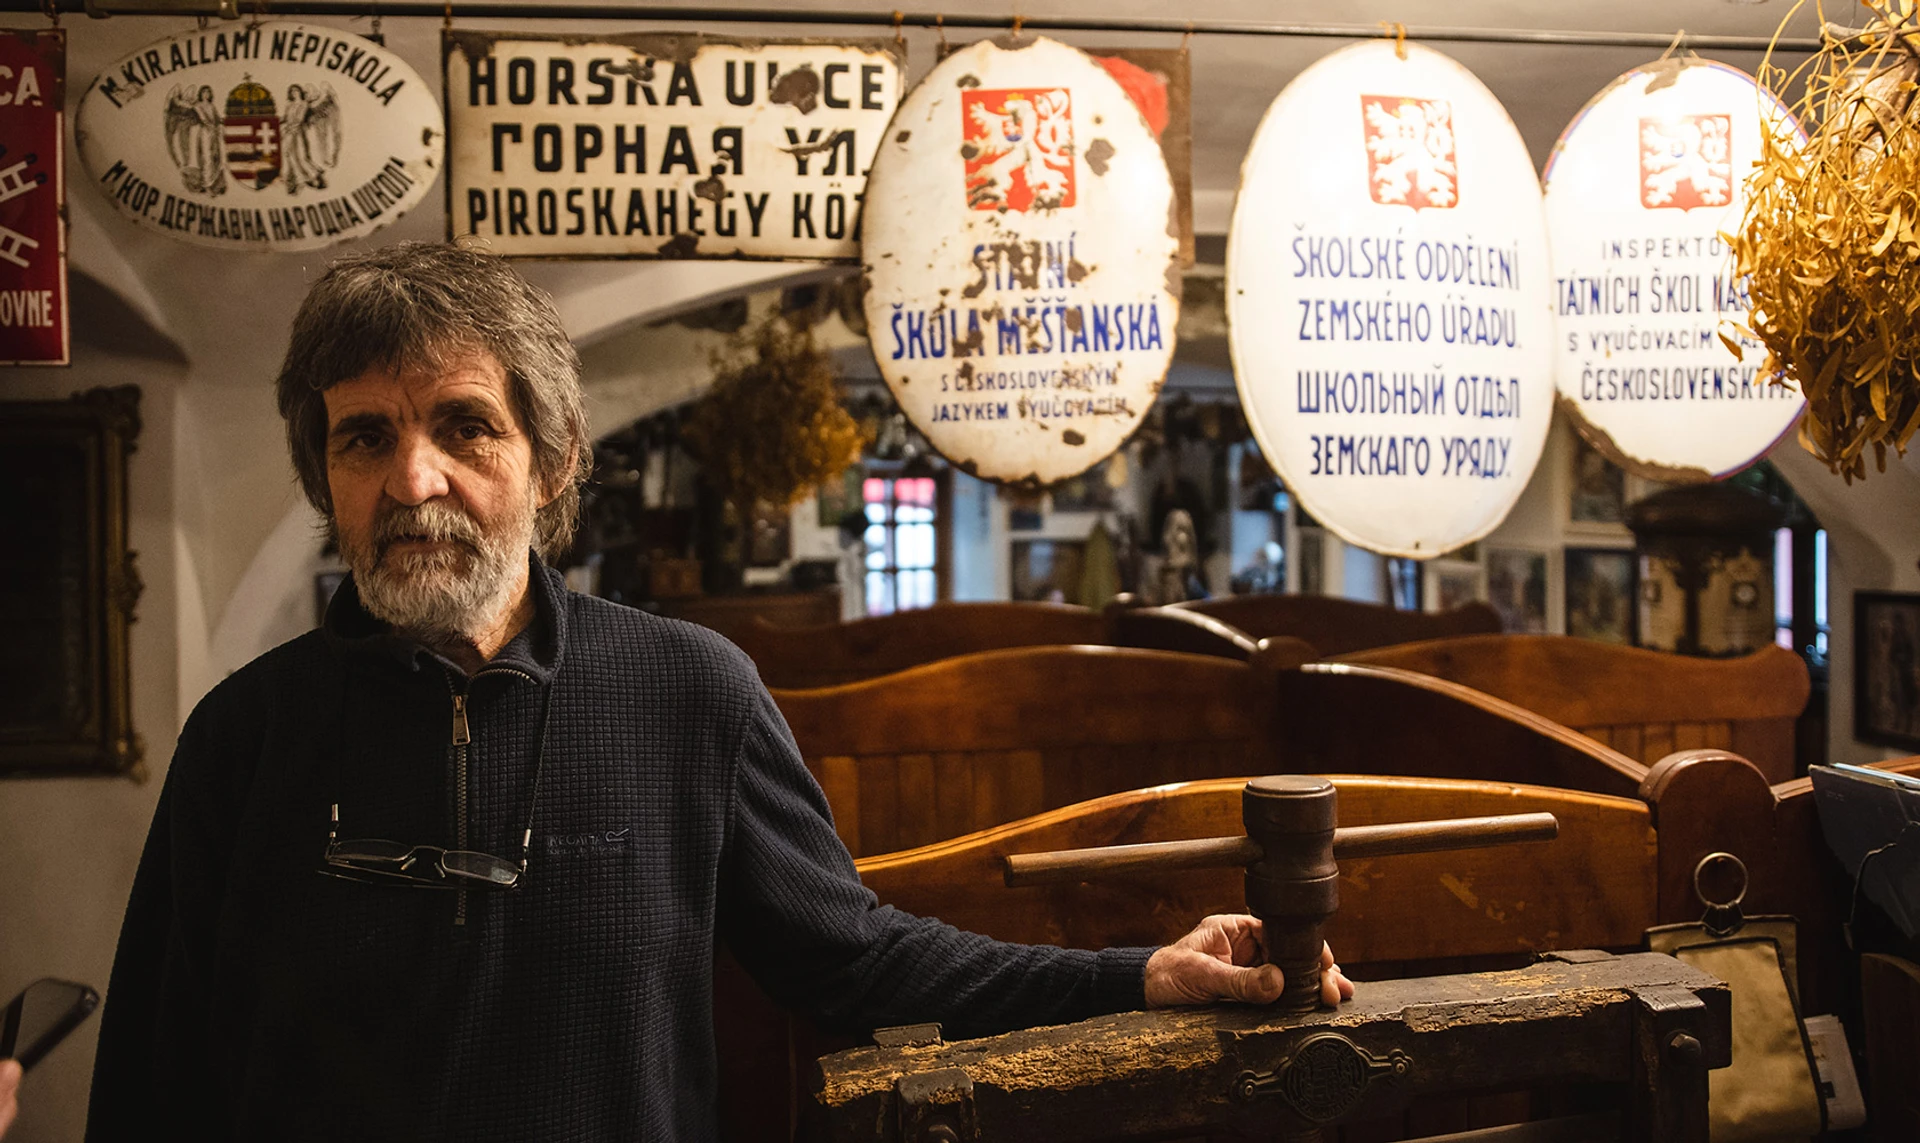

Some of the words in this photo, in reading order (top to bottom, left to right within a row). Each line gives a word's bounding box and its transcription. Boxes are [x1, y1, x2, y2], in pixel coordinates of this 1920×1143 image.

[269, 26, 406, 106] NÉPISKOLA
[726, 60, 884, 110] UCE
[492, 123, 744, 175] ГОРНАЯ
[268, 196, 363, 241] НАРОДНА
[468, 187, 770, 238] PIROSKAHEGY
[1292, 223, 1406, 280] ŠKOLSKÉ
[1416, 233, 1520, 290] ODDĚLENÍ
[1602, 236, 1733, 260] INSPEKTO
[1650, 266, 1704, 314] ŠKOL
[891, 301, 985, 360] ŠKOLA
[1298, 290, 1431, 342] ZEMSKÉHO
[1568, 332, 1579, 352] S
[1589, 323, 1714, 351] VYUČOVACÍM
[941, 373, 949, 392] S
[1297, 363, 1446, 415] ШКОЛЬНЫЙ
[932, 401, 1009, 423] JAZYKEM
[1310, 434, 1431, 476] ЗЕМСКАГО
